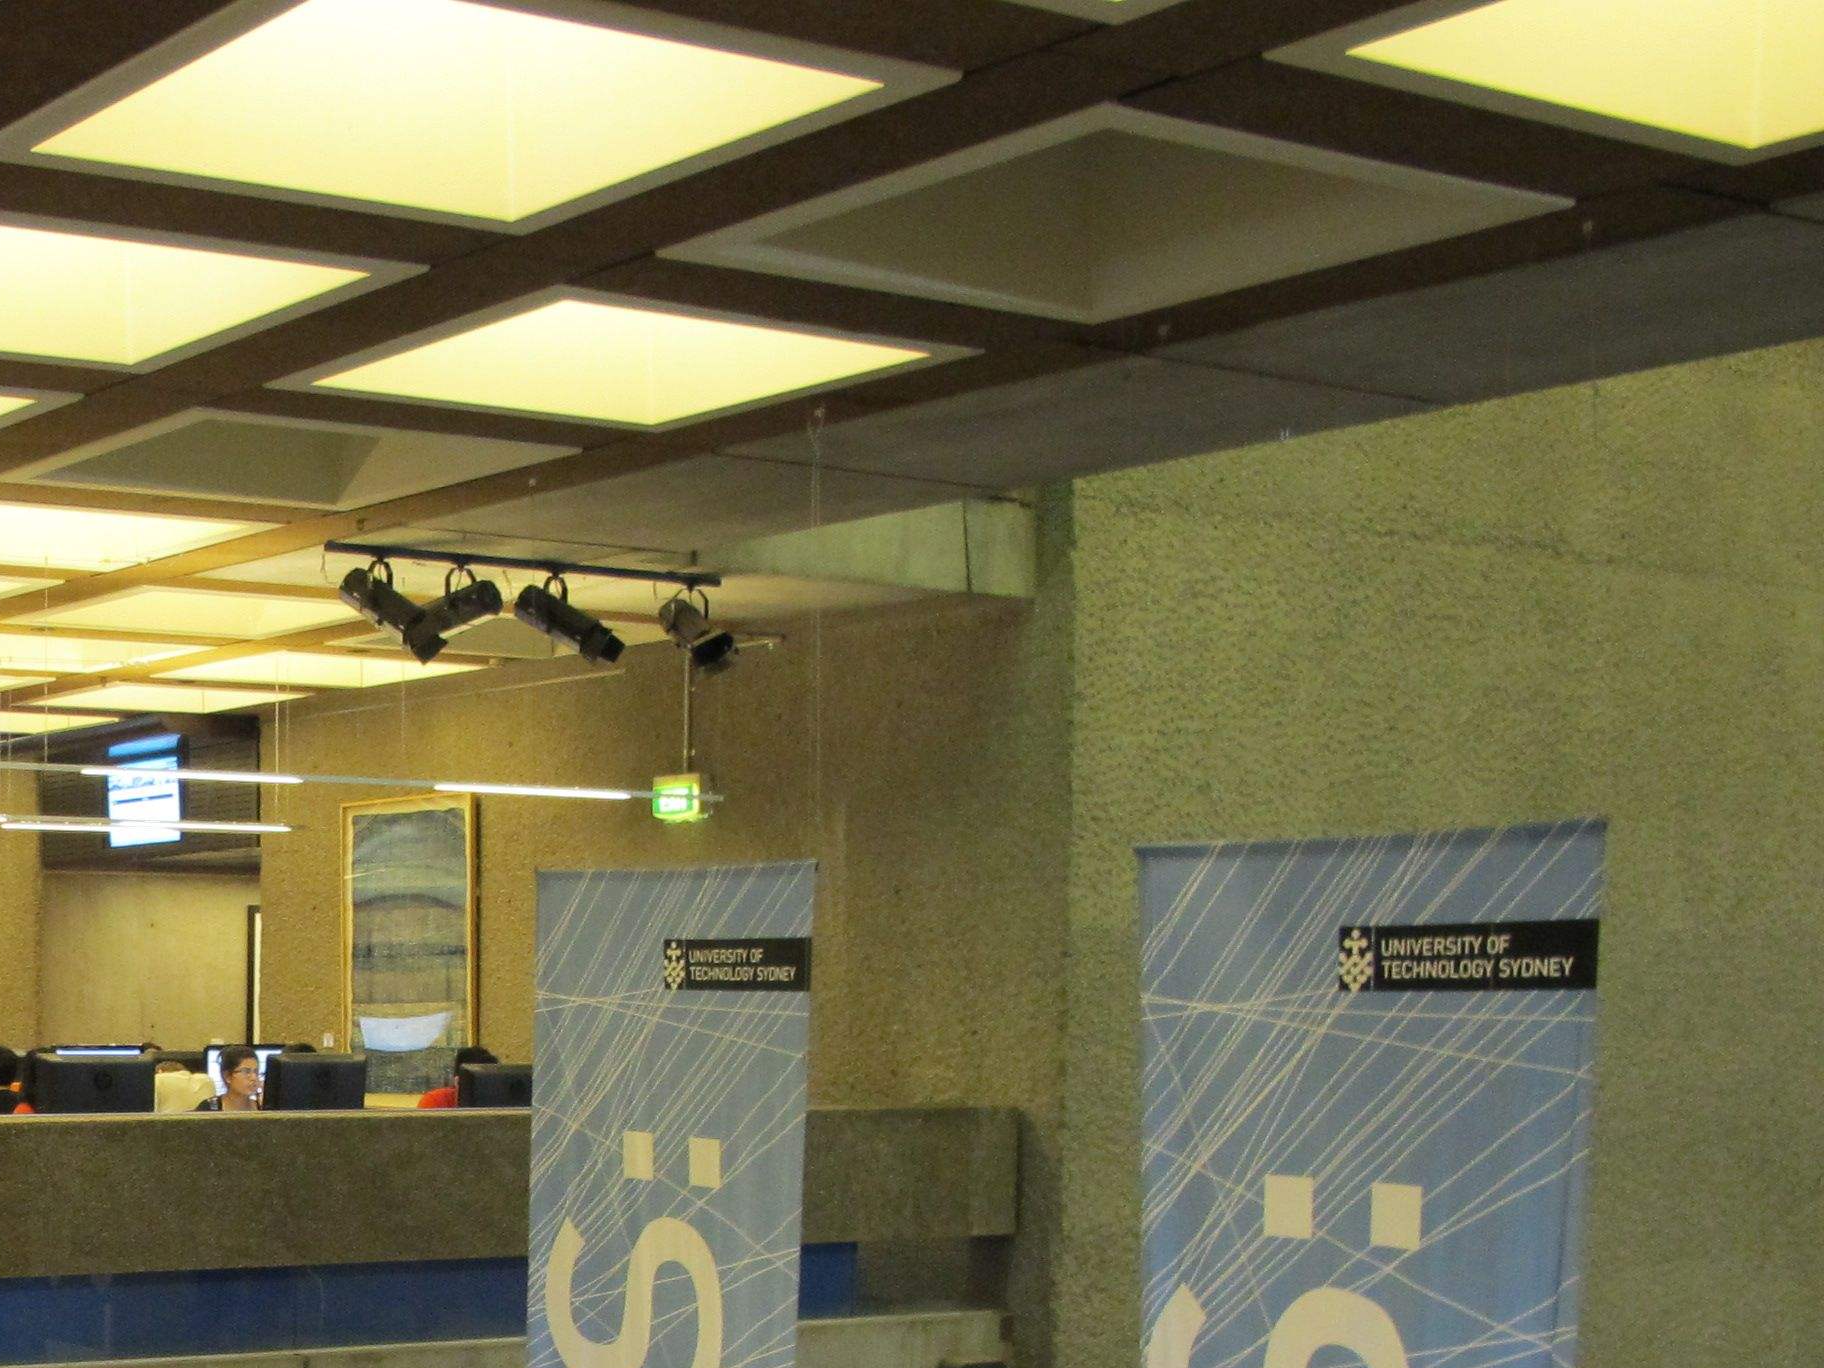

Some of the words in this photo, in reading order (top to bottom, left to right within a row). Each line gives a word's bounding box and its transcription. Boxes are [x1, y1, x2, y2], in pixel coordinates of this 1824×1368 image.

[1381, 935, 1482, 957] UNIVERSITY
[1486, 934, 1512, 954] OF
[688, 949, 747, 963] UNIVERSITY
[749, 948, 764, 962] OF
[689, 966, 754, 981] TECHNOLOGY
[756, 966, 796, 981] SYDNEY
[1382, 958, 1495, 980] TECHNOLOGY
[1498, 956, 1574, 978] SYDNEY
